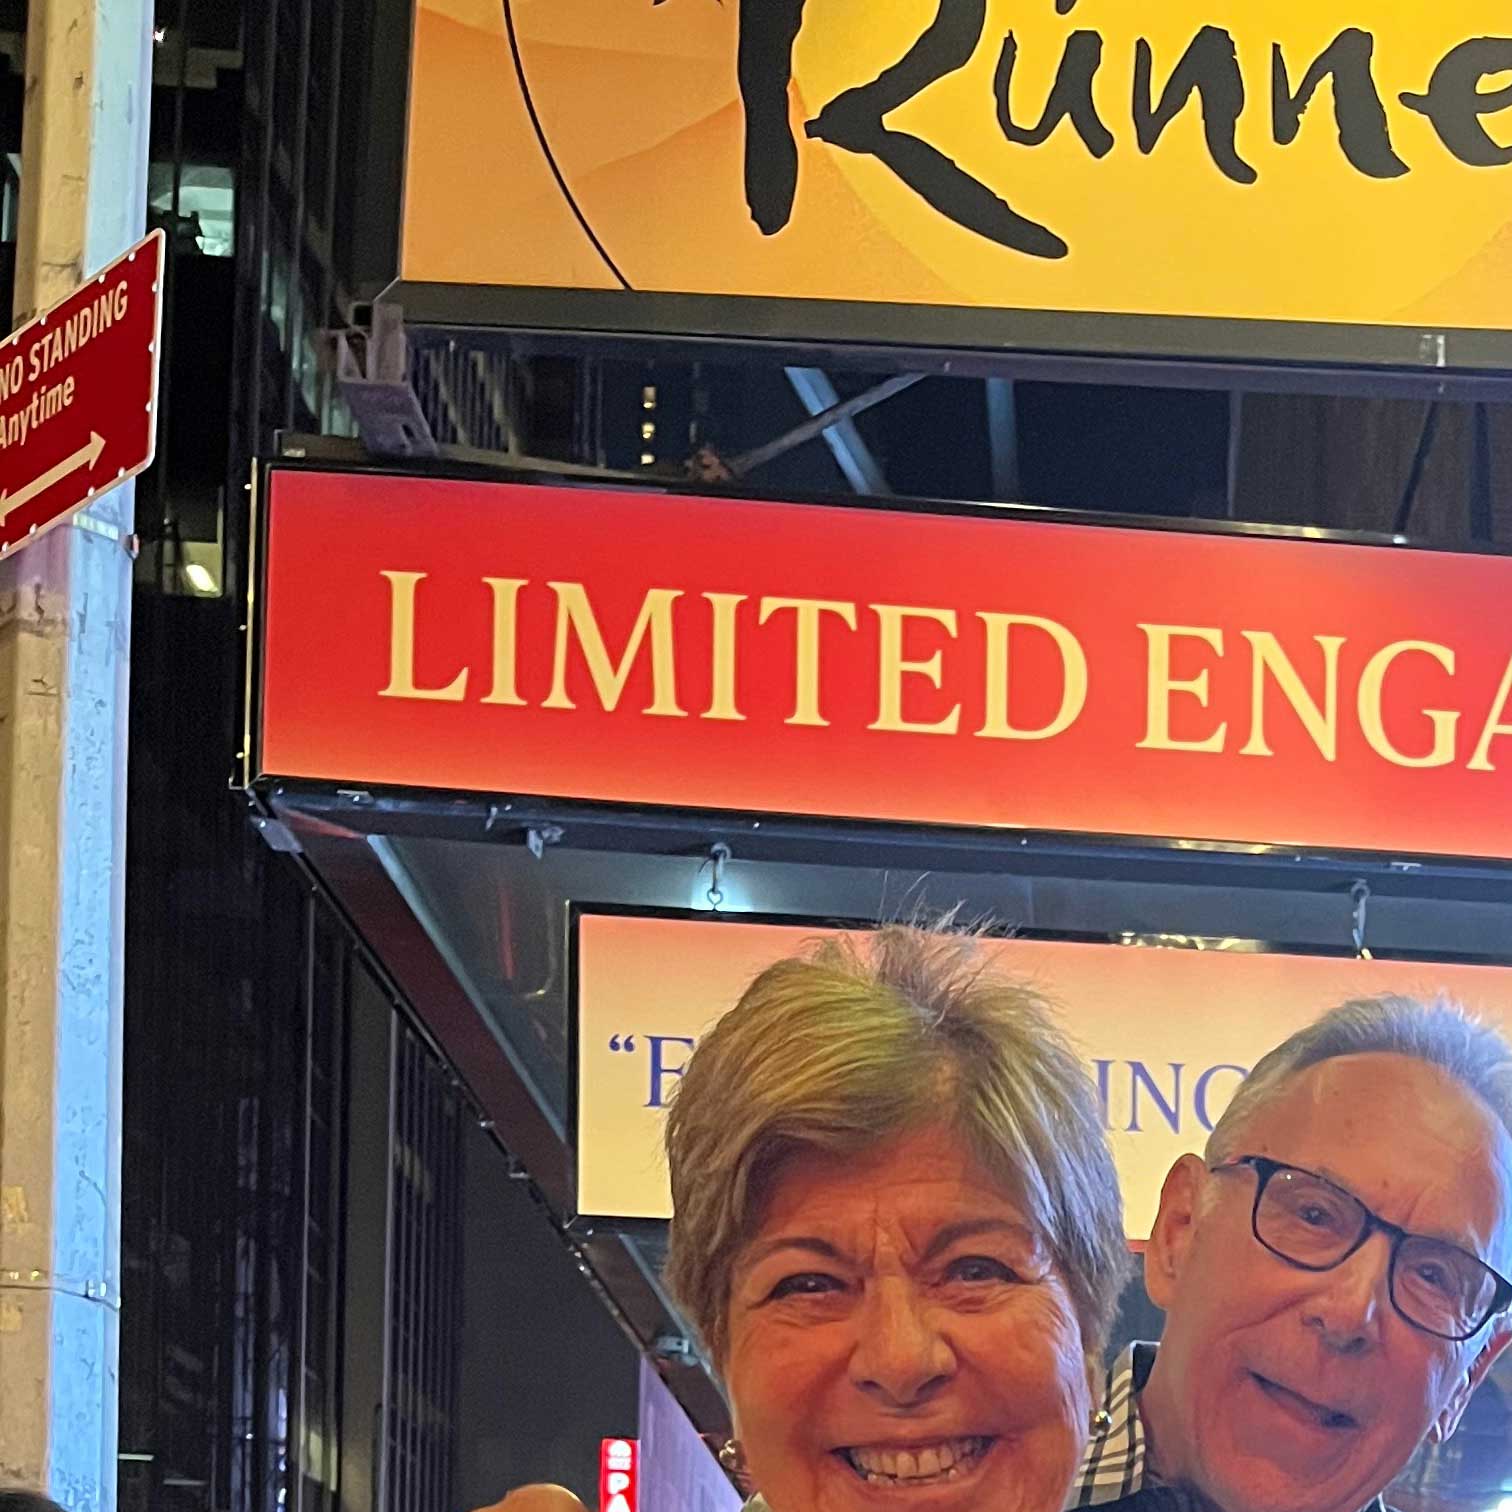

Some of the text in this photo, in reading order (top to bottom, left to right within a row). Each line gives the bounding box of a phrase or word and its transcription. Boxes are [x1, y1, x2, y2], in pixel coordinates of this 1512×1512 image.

[0, 280, 128, 401] NO STANDING
[0, 376, 75, 449] Anytime
[377, 569, 1089, 741] LIMITED
